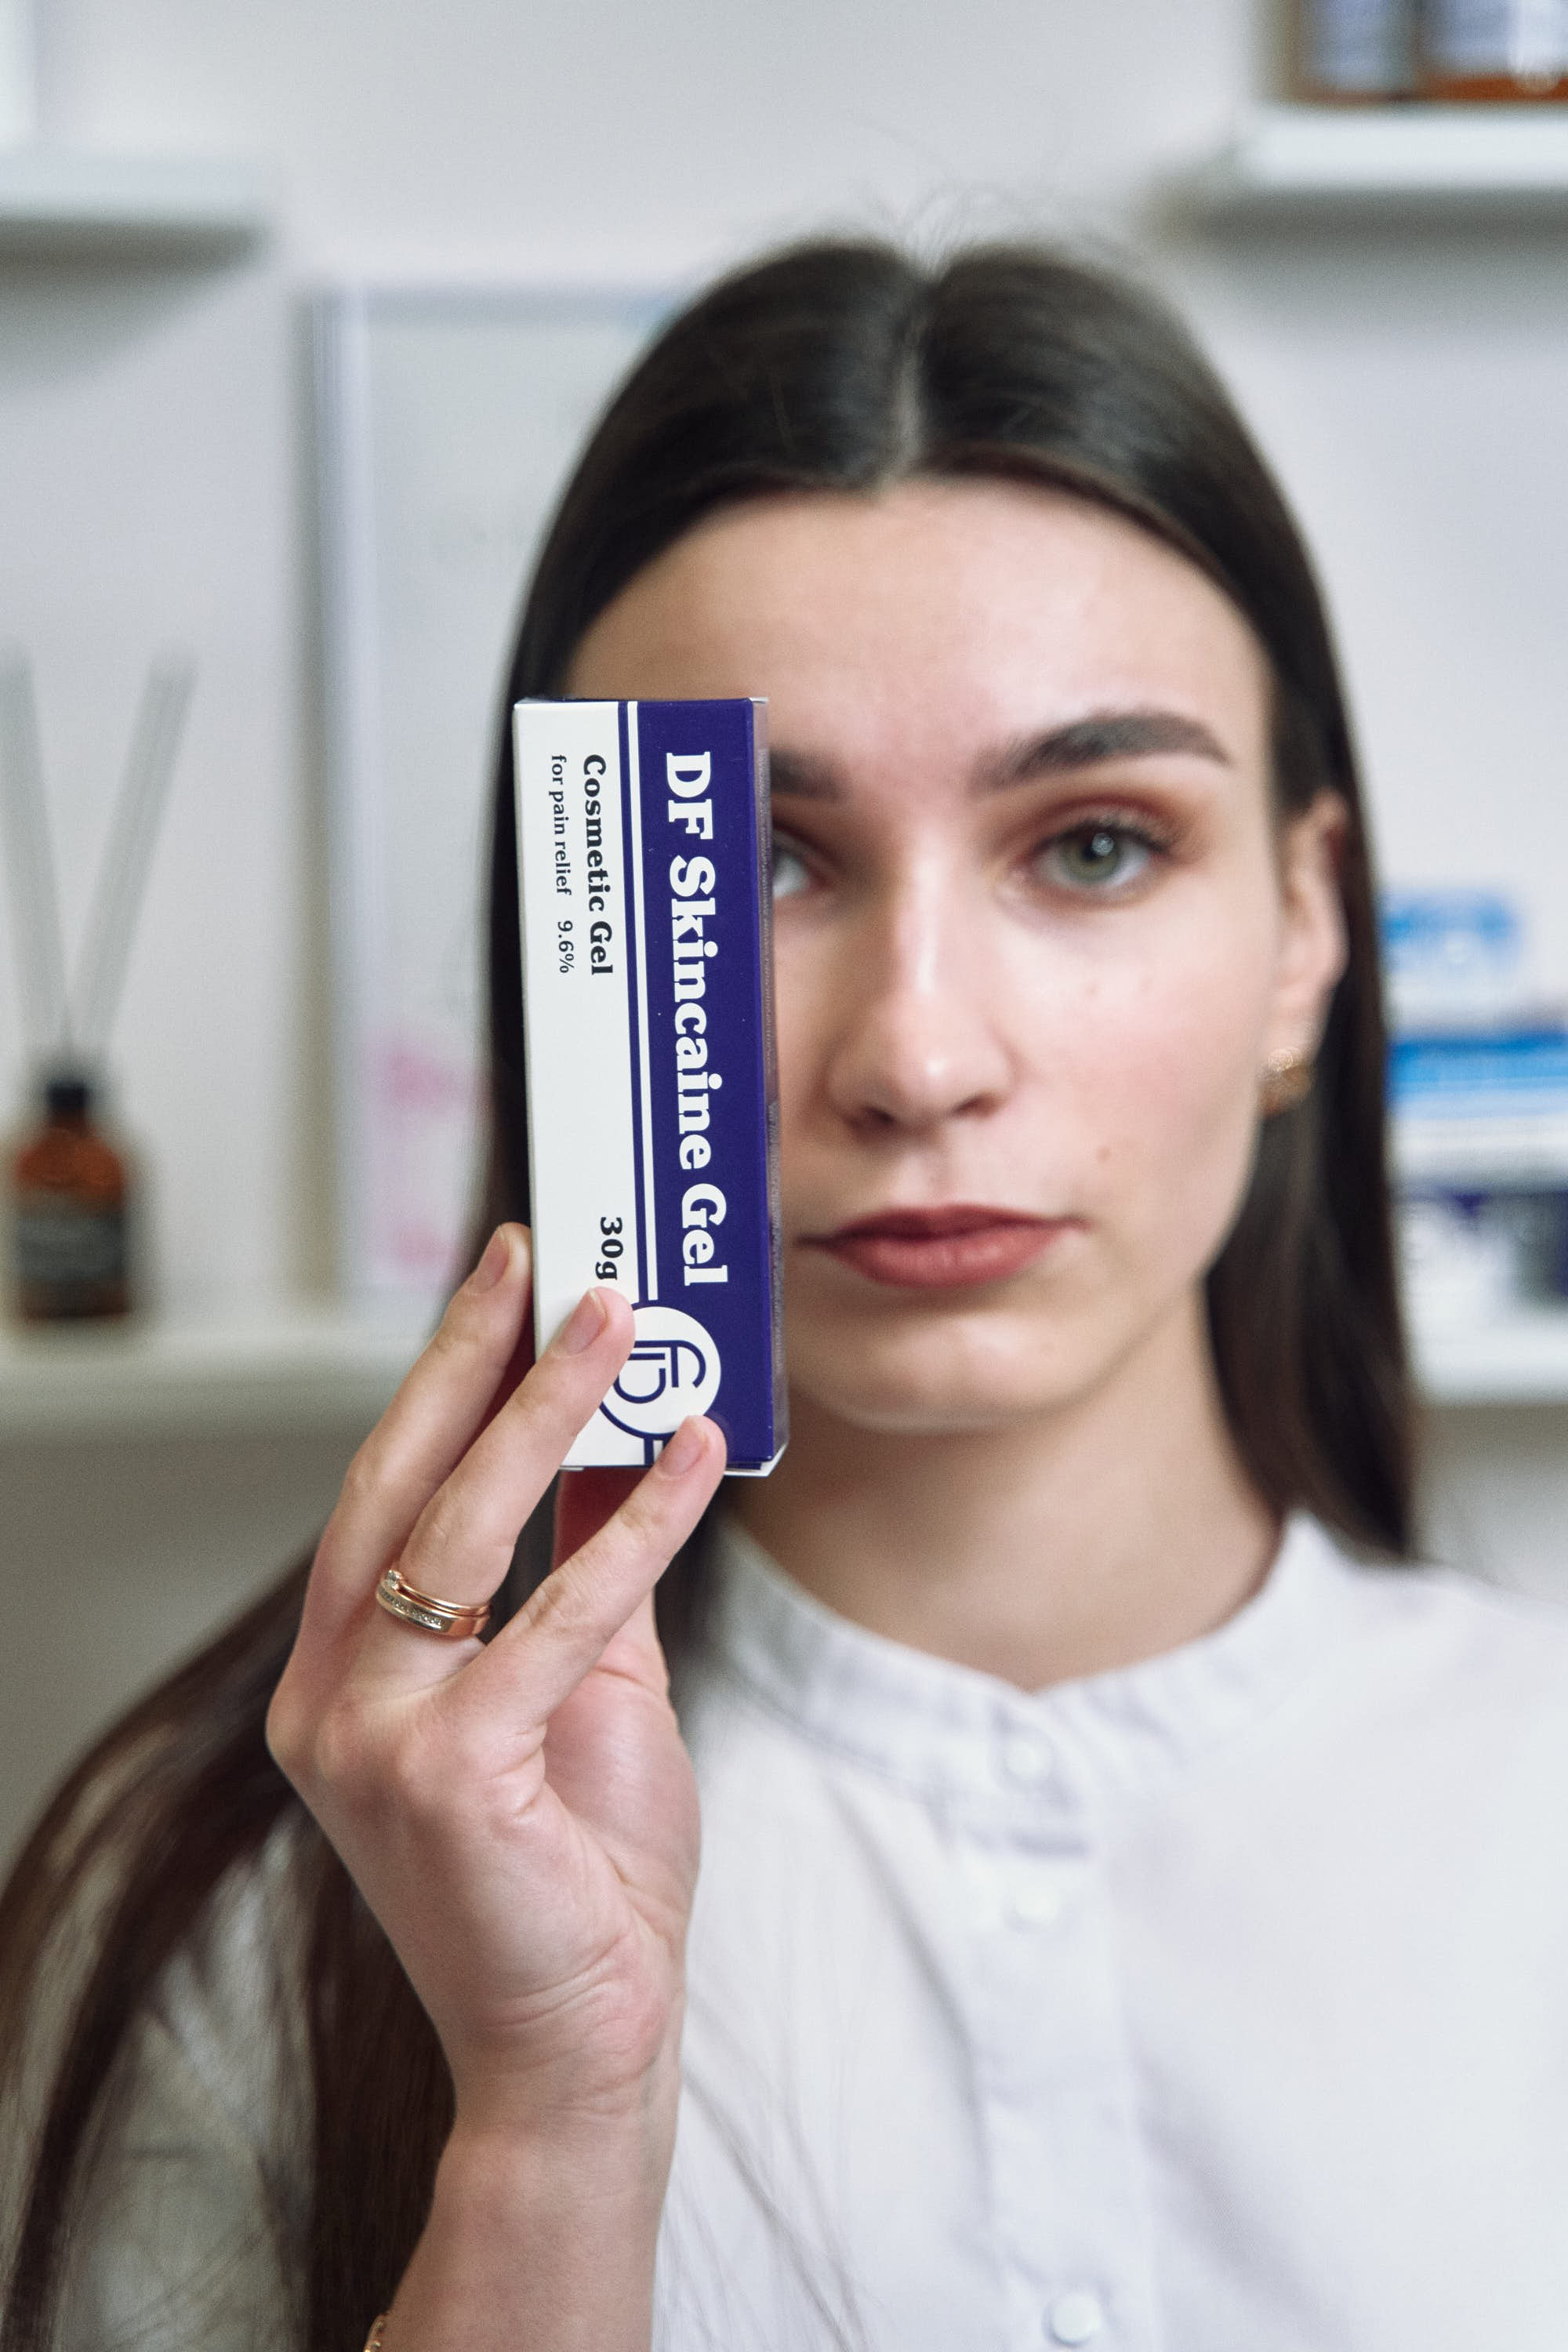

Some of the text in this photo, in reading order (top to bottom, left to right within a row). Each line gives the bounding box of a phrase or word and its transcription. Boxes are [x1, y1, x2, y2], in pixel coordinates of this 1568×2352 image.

[549, 754, 575, 974] for pain relief 9.6%
[583, 754, 613, 975] Cosmetic Gel
[666, 751, 728, 1287] DF Skincaine Gel
[595, 1216, 624, 1280] 30g
